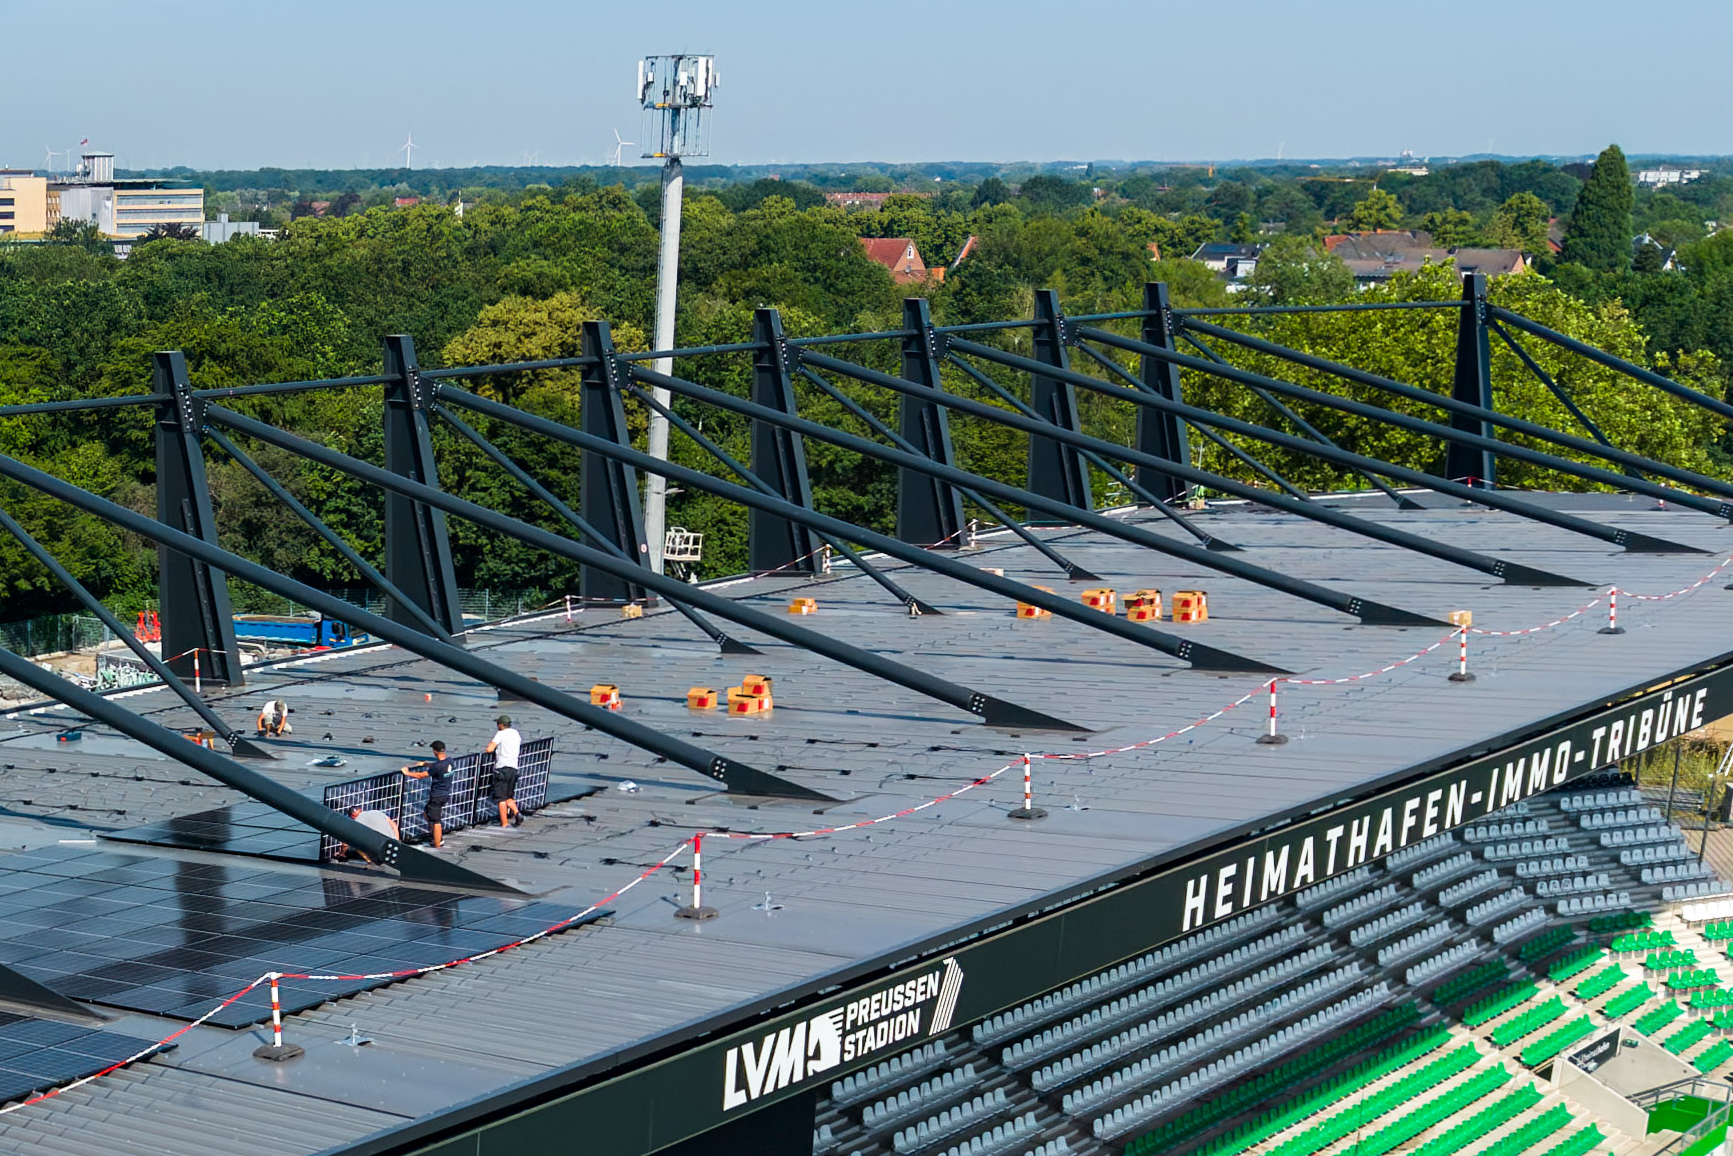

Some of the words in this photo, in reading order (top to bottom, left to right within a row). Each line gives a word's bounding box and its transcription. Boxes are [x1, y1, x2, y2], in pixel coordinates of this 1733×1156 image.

[1182, 688, 1708, 932] HEIMATHAFEN-IMMO-TRIBÜNE
[844, 1008, 920, 1062] STADION
[846, 971, 940, 1031] PREUSSEN
[723, 1019, 806, 1111] LVM
